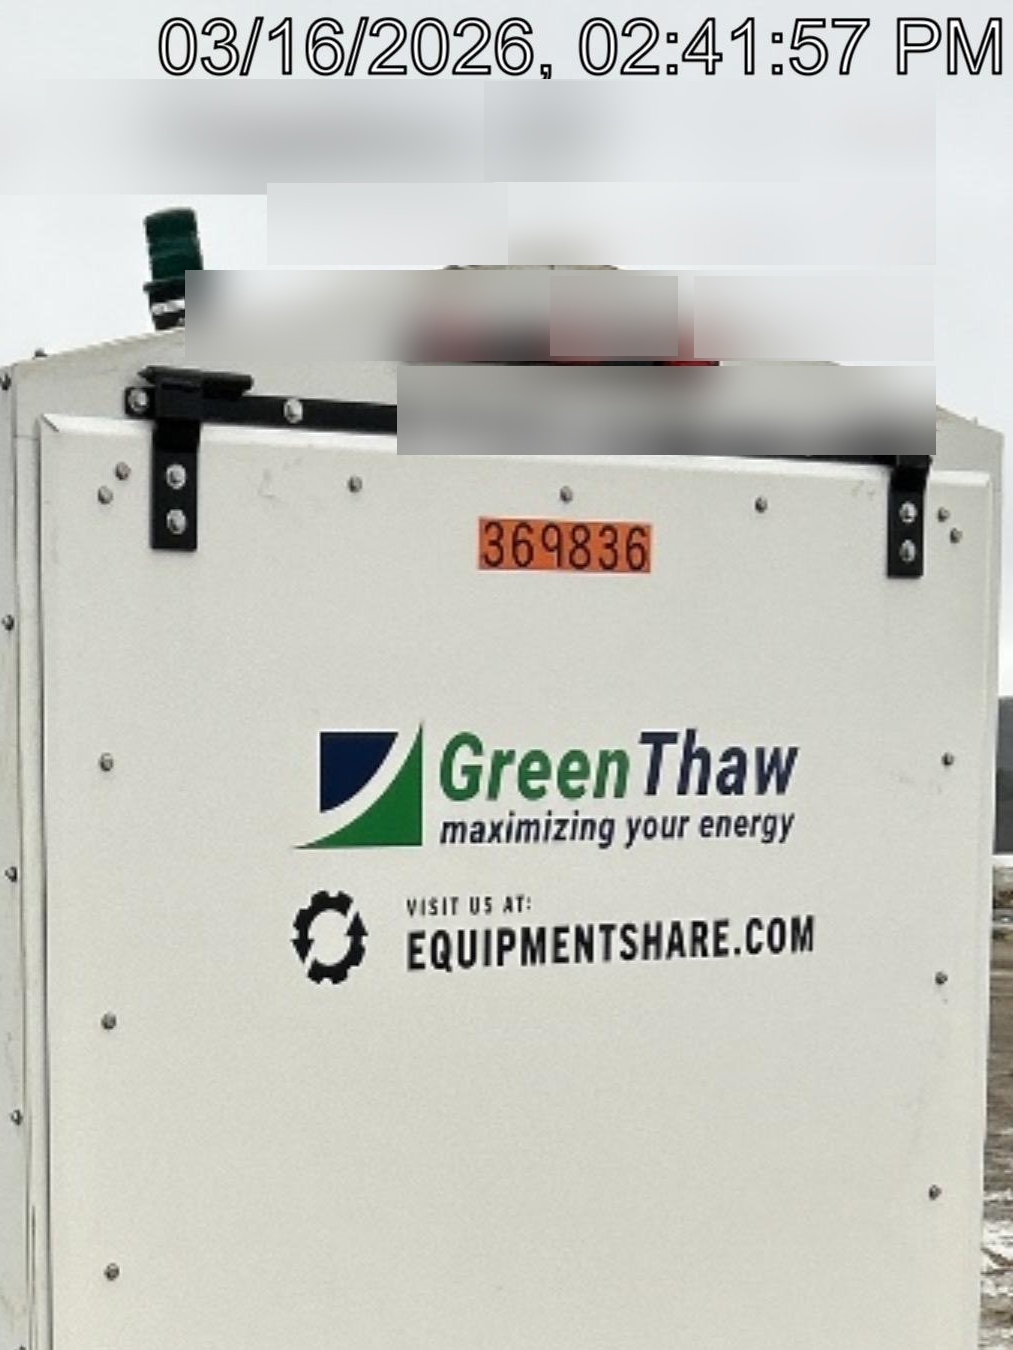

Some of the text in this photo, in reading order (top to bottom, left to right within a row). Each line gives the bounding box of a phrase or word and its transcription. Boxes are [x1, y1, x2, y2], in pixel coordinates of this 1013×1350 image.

[482, 520, 648, 571] 369836
[439, 810, 795, 849] maximizing your energy
[406, 895, 532, 917] VISIT US AT:
[406, 915, 816, 972] EQUIPMENTSHARE.COM
